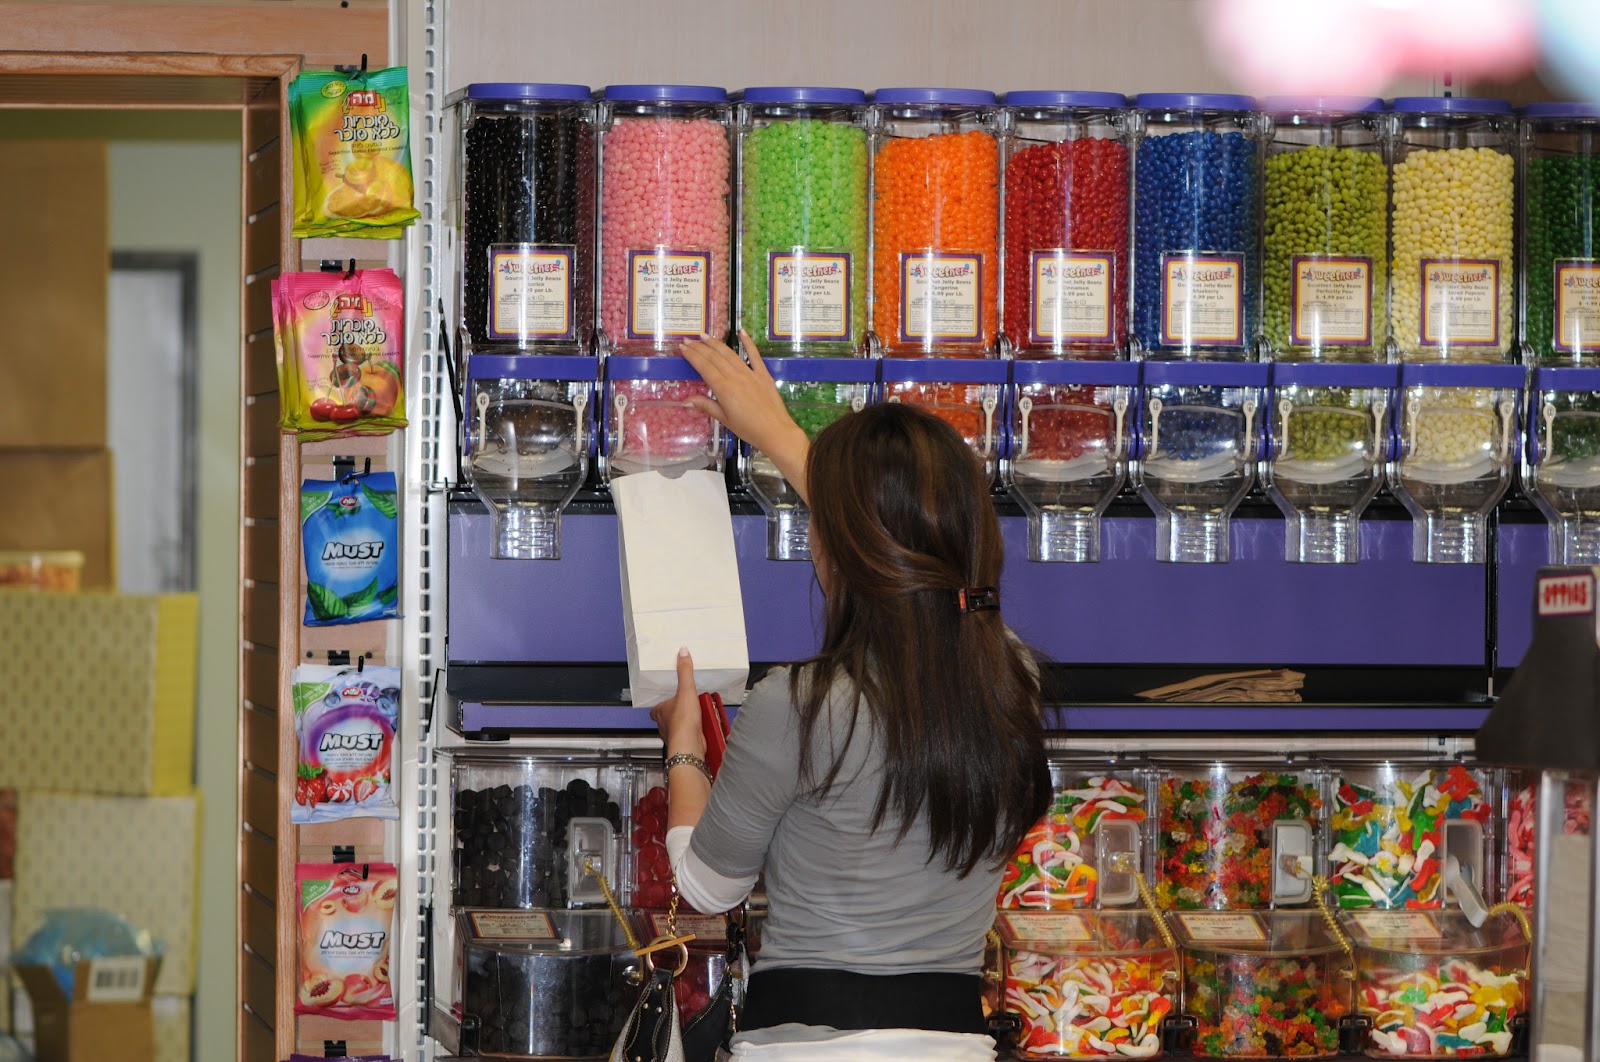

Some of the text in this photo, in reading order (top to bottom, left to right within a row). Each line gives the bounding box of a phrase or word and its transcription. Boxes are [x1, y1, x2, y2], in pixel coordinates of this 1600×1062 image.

[334, 121, 400, 141] ללא סוכר
[321, 327, 386, 346] ללא סוכר
[322, 541, 384, 560] MUST
[320, 733, 384, 752] MUST
[320, 930, 385, 949] MUST
